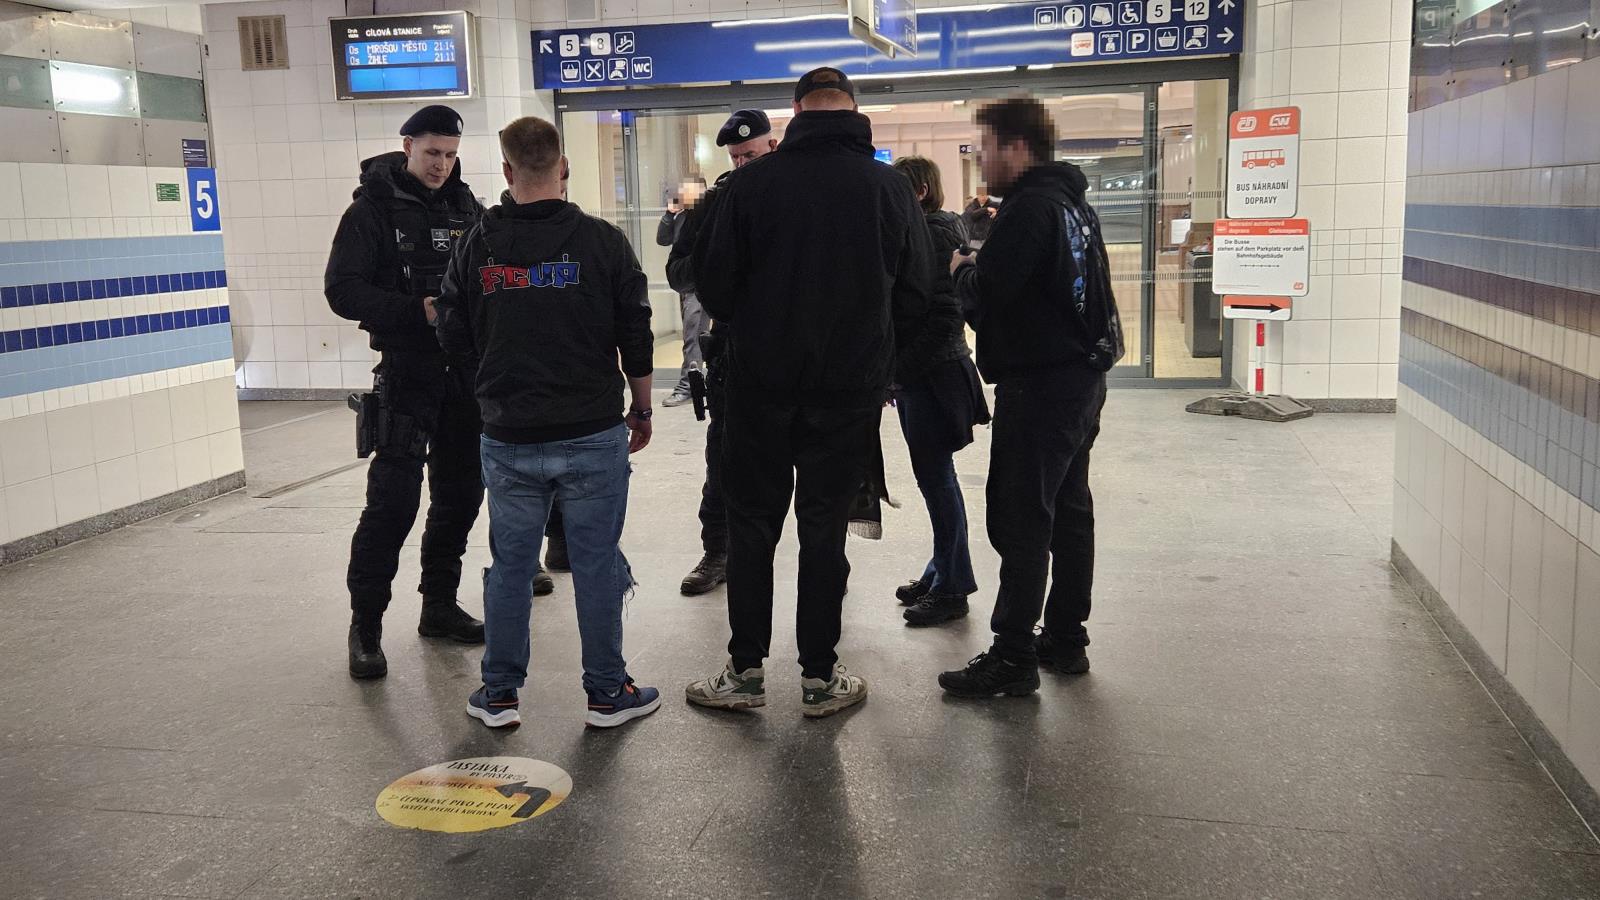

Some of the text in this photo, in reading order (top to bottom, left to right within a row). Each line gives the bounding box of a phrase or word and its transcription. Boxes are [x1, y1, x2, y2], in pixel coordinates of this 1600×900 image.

[1154, 5, 1163, 17] 5
[1189, 3, 1205, 16] 12
[365, 27, 422, 37] CÍLOVÁ STANICE
[401, 40, 428, 53] MĚSTO
[566, 39, 573, 52] 5
[1131, 33, 1145, 49] P
[634, 63, 650, 73] WC
[1236, 179, 1289, 192] BUS NÁHRADNÍ
[196, 180, 213, 219] 5
[1244, 196, 1278, 205] DOPRAVY
[449, 799, 475, 808] PIVO
